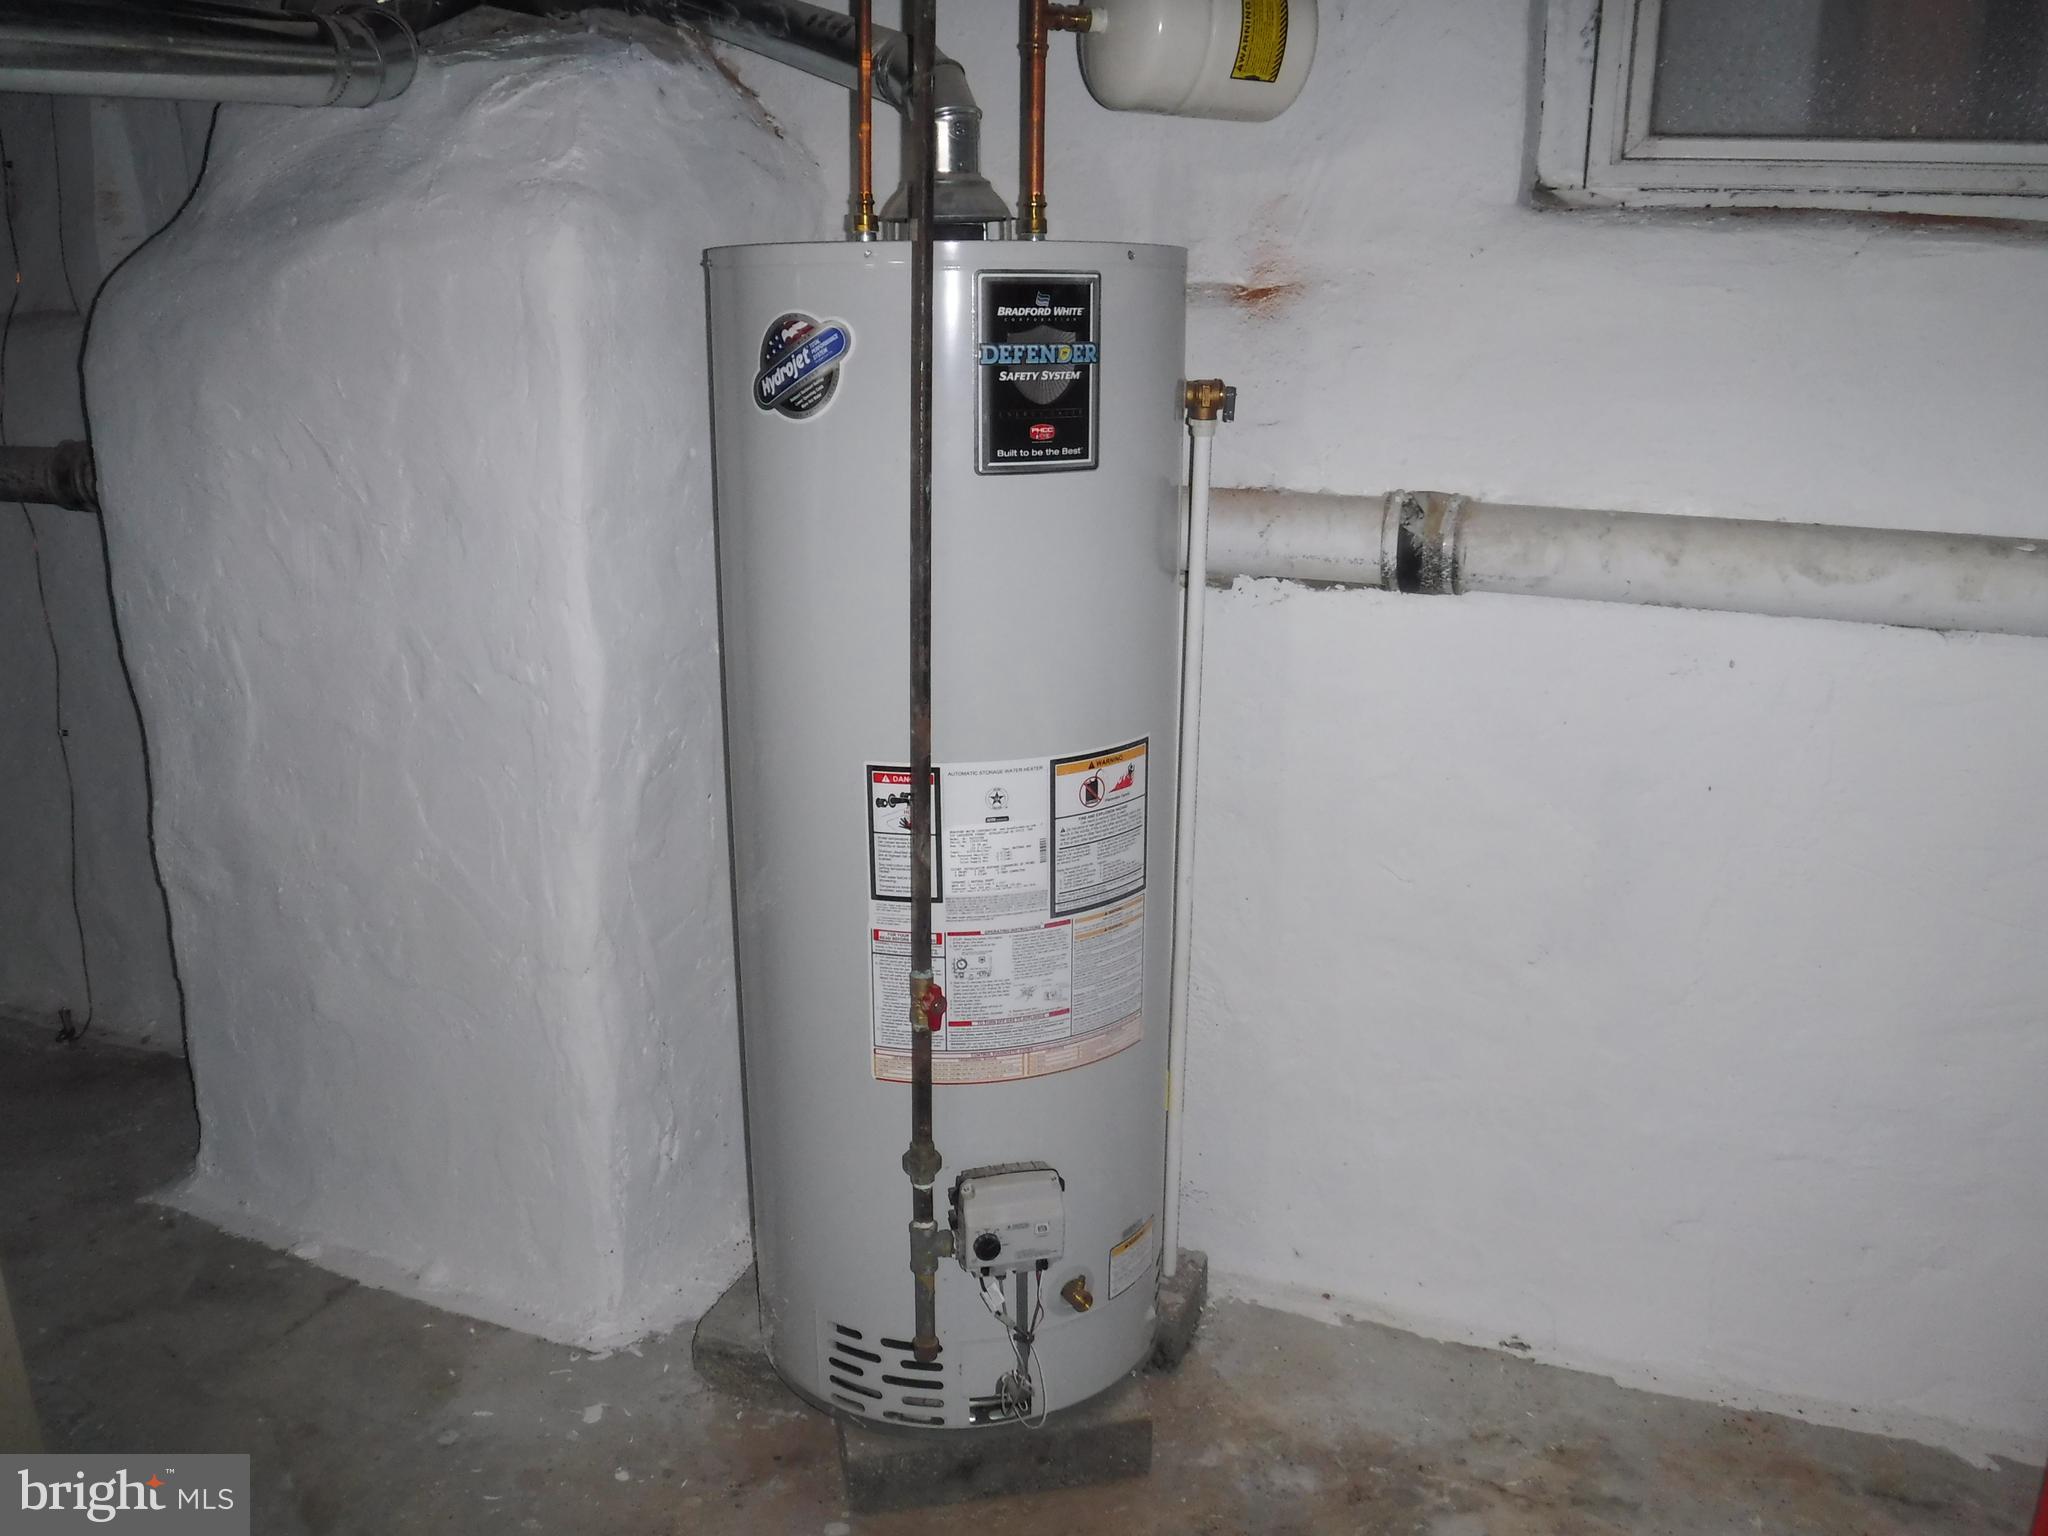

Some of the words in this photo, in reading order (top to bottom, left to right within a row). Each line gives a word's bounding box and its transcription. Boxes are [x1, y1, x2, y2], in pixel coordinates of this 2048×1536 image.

[1239, 1, 1252, 62] WARNING
[997, 306, 1051, 316] BRADFORD
[1053, 306, 1084, 316] WHITE
[979, 343, 1098, 364] DEFENDER
[761, 346, 811, 397] Hydrojet
[999, 371, 1040, 381] SAFETY
[1041, 370, 1080, 380] SYSTEM
[997, 449, 1018, 457] Built
[1032, 448, 1043, 456] be
[1046, 448, 1059, 456] the
[1062, 447, 1081, 455] Best
[1096, 756, 1123, 767] WARNING
